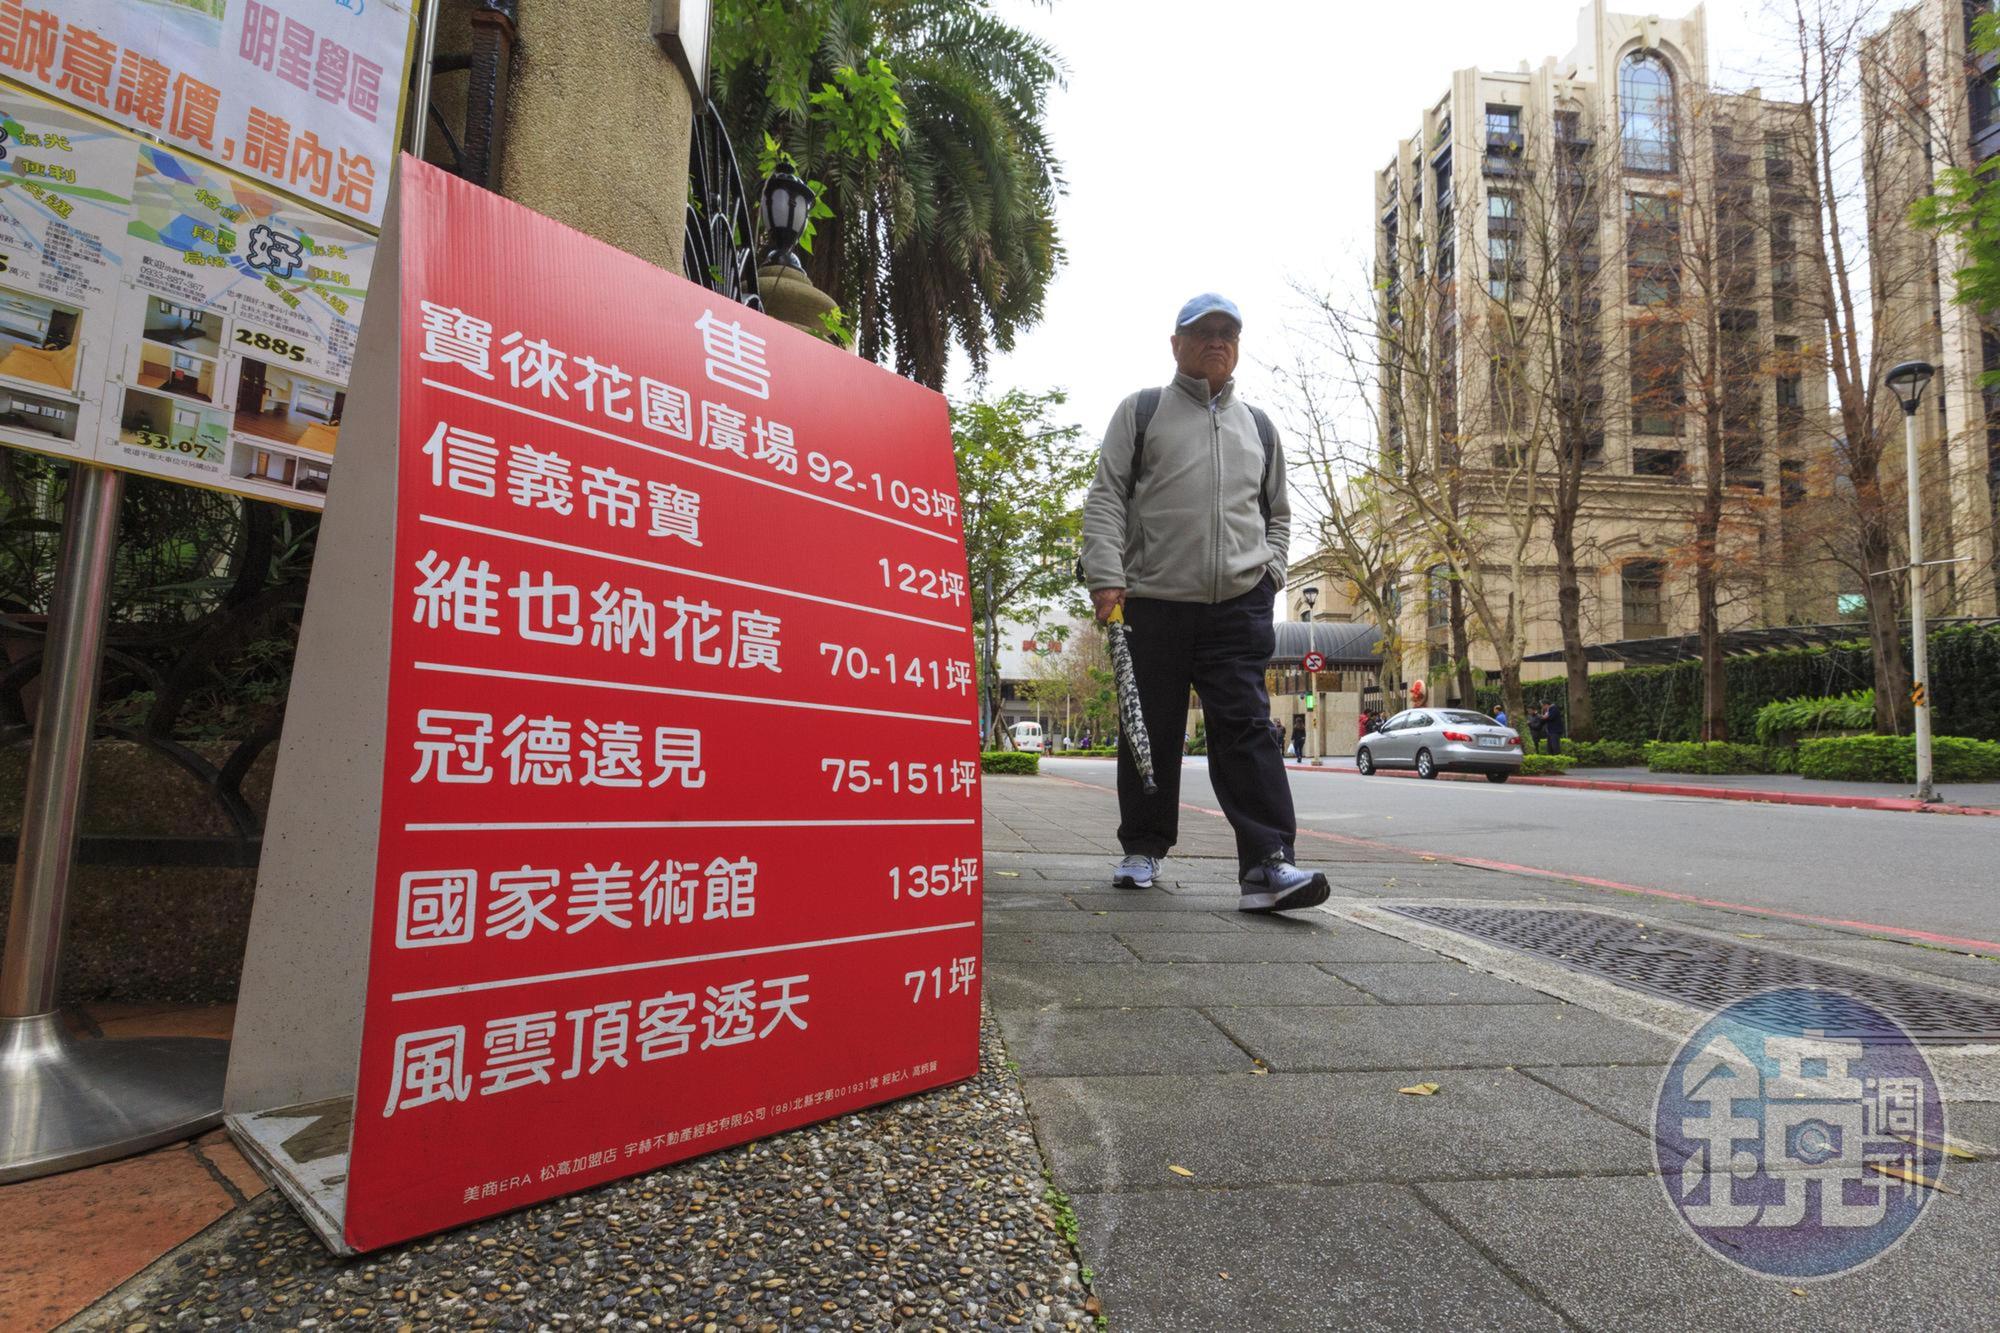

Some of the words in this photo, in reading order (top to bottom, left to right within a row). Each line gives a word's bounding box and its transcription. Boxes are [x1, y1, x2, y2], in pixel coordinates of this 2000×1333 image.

[240, 0, 383, 123] 明星學區
[246, 224, 303, 279] 好
[236, 328, 306, 362] 2885
[695, 309, 771, 400] 售
[136, 429, 208, 459] 33.07
[420, 300, 798, 475] 寶徠花園廣場
[808, 452, 958, 527] 92-103坪
[422, 421, 703, 548] 信義帝寶
[878, 558, 966, 608] 122坪
[412, 549, 783, 673] 維也納花廣
[820, 642, 972, 695] 70-141坪
[410, 709, 706, 789] 冠德遠見
[821, 759, 977, 798] 75-151坪
[395, 856, 758, 949] 國家美術館
[888, 857, 979, 901] 135坪
[382, 974, 810, 1118] 風雲頂客透天
[904, 956, 976, 1004] 71坪
[463, 1173, 532, 1204] 美商ERA
[540, 1148, 618, 1183] 松高加盟店
